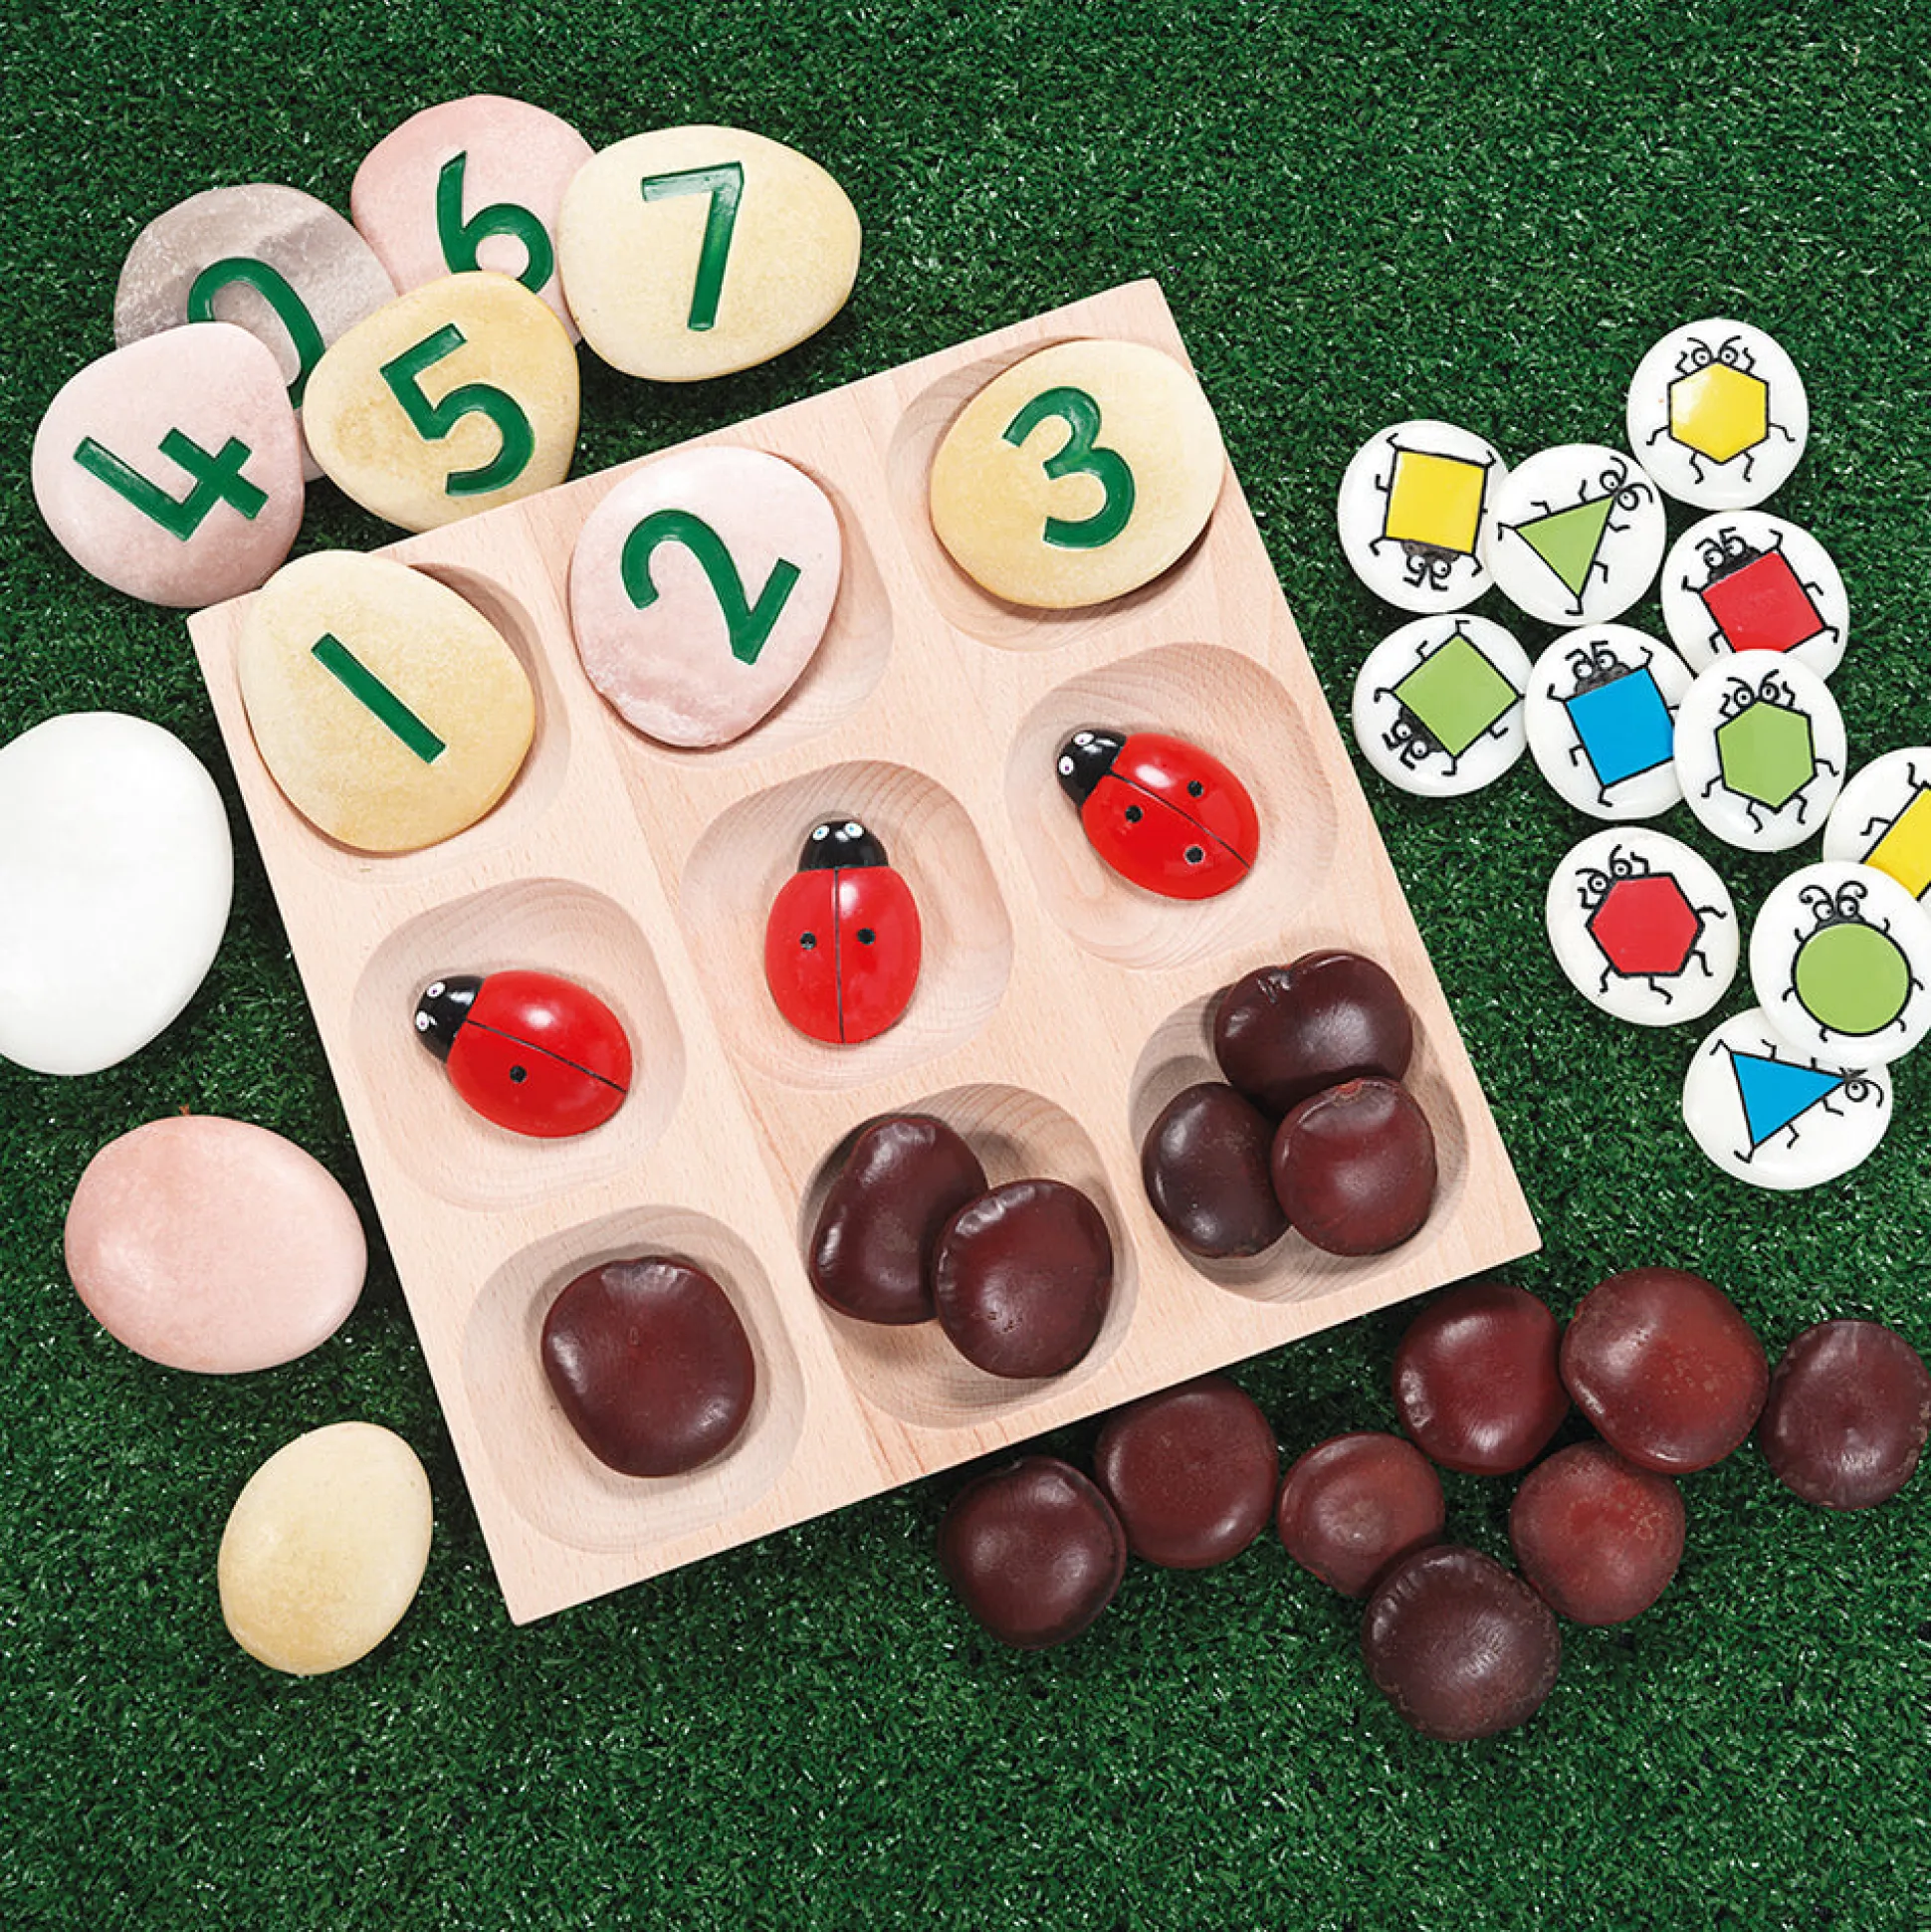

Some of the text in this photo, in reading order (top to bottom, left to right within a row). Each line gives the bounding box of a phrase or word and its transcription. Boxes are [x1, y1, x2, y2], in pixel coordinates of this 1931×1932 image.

[436, 151, 554, 294] 6
[641, 161, 745, 331] 7
[73, 428, 269, 541] 4
[379, 322, 535, 496] 5
[1001, 386, 1136, 548] 3
[620, 509, 801, 666] 2
[311, 633, 446, 763] 1
